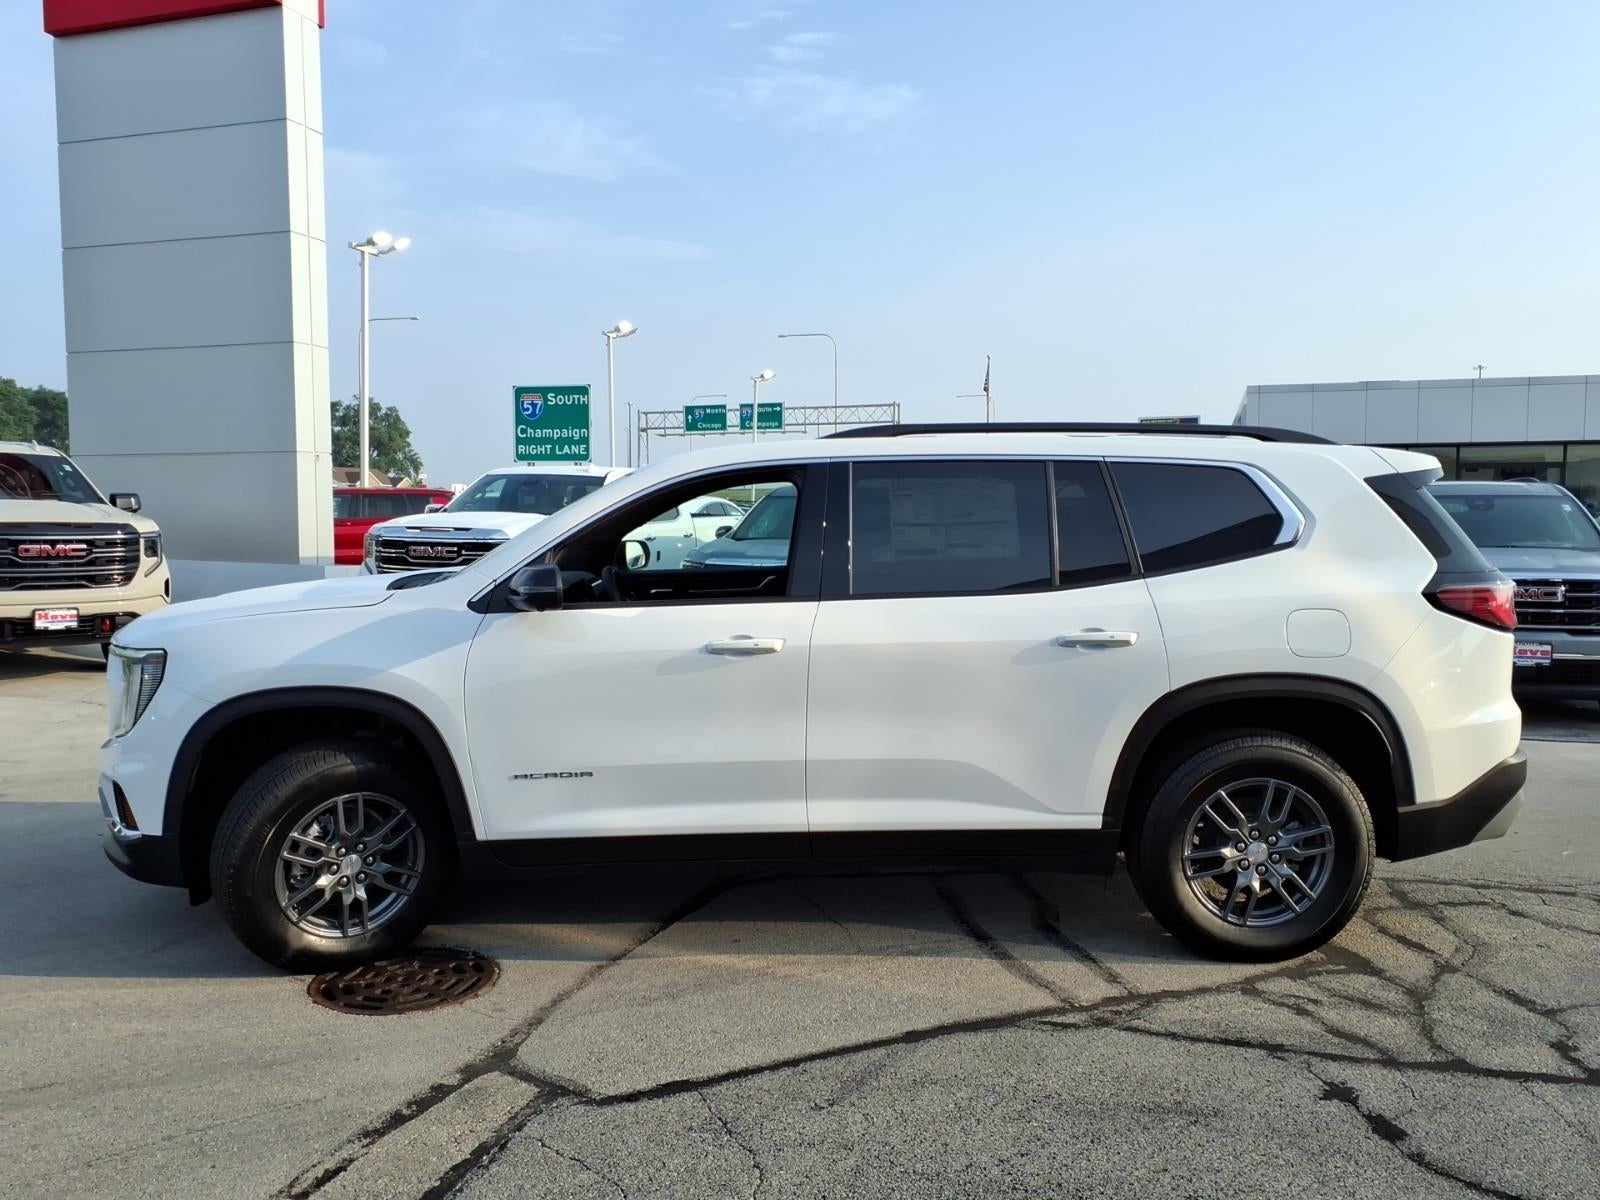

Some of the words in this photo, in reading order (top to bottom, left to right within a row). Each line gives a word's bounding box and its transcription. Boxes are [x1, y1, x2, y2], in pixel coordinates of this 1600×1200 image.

[523, 400, 542, 415] 57
[547, 392, 588, 405] SOUTH
[695, 411, 705, 419] 57
[517, 425, 588, 440] Champaign
[518, 445, 552, 455] RIGHT
[555, 445, 587, 455] LANE
[18, 544, 87, 556] GMC
[409, 546, 458, 557] GMC
[1515, 586, 1564, 602] MC
[508, 771, 593, 780] ACADIA
